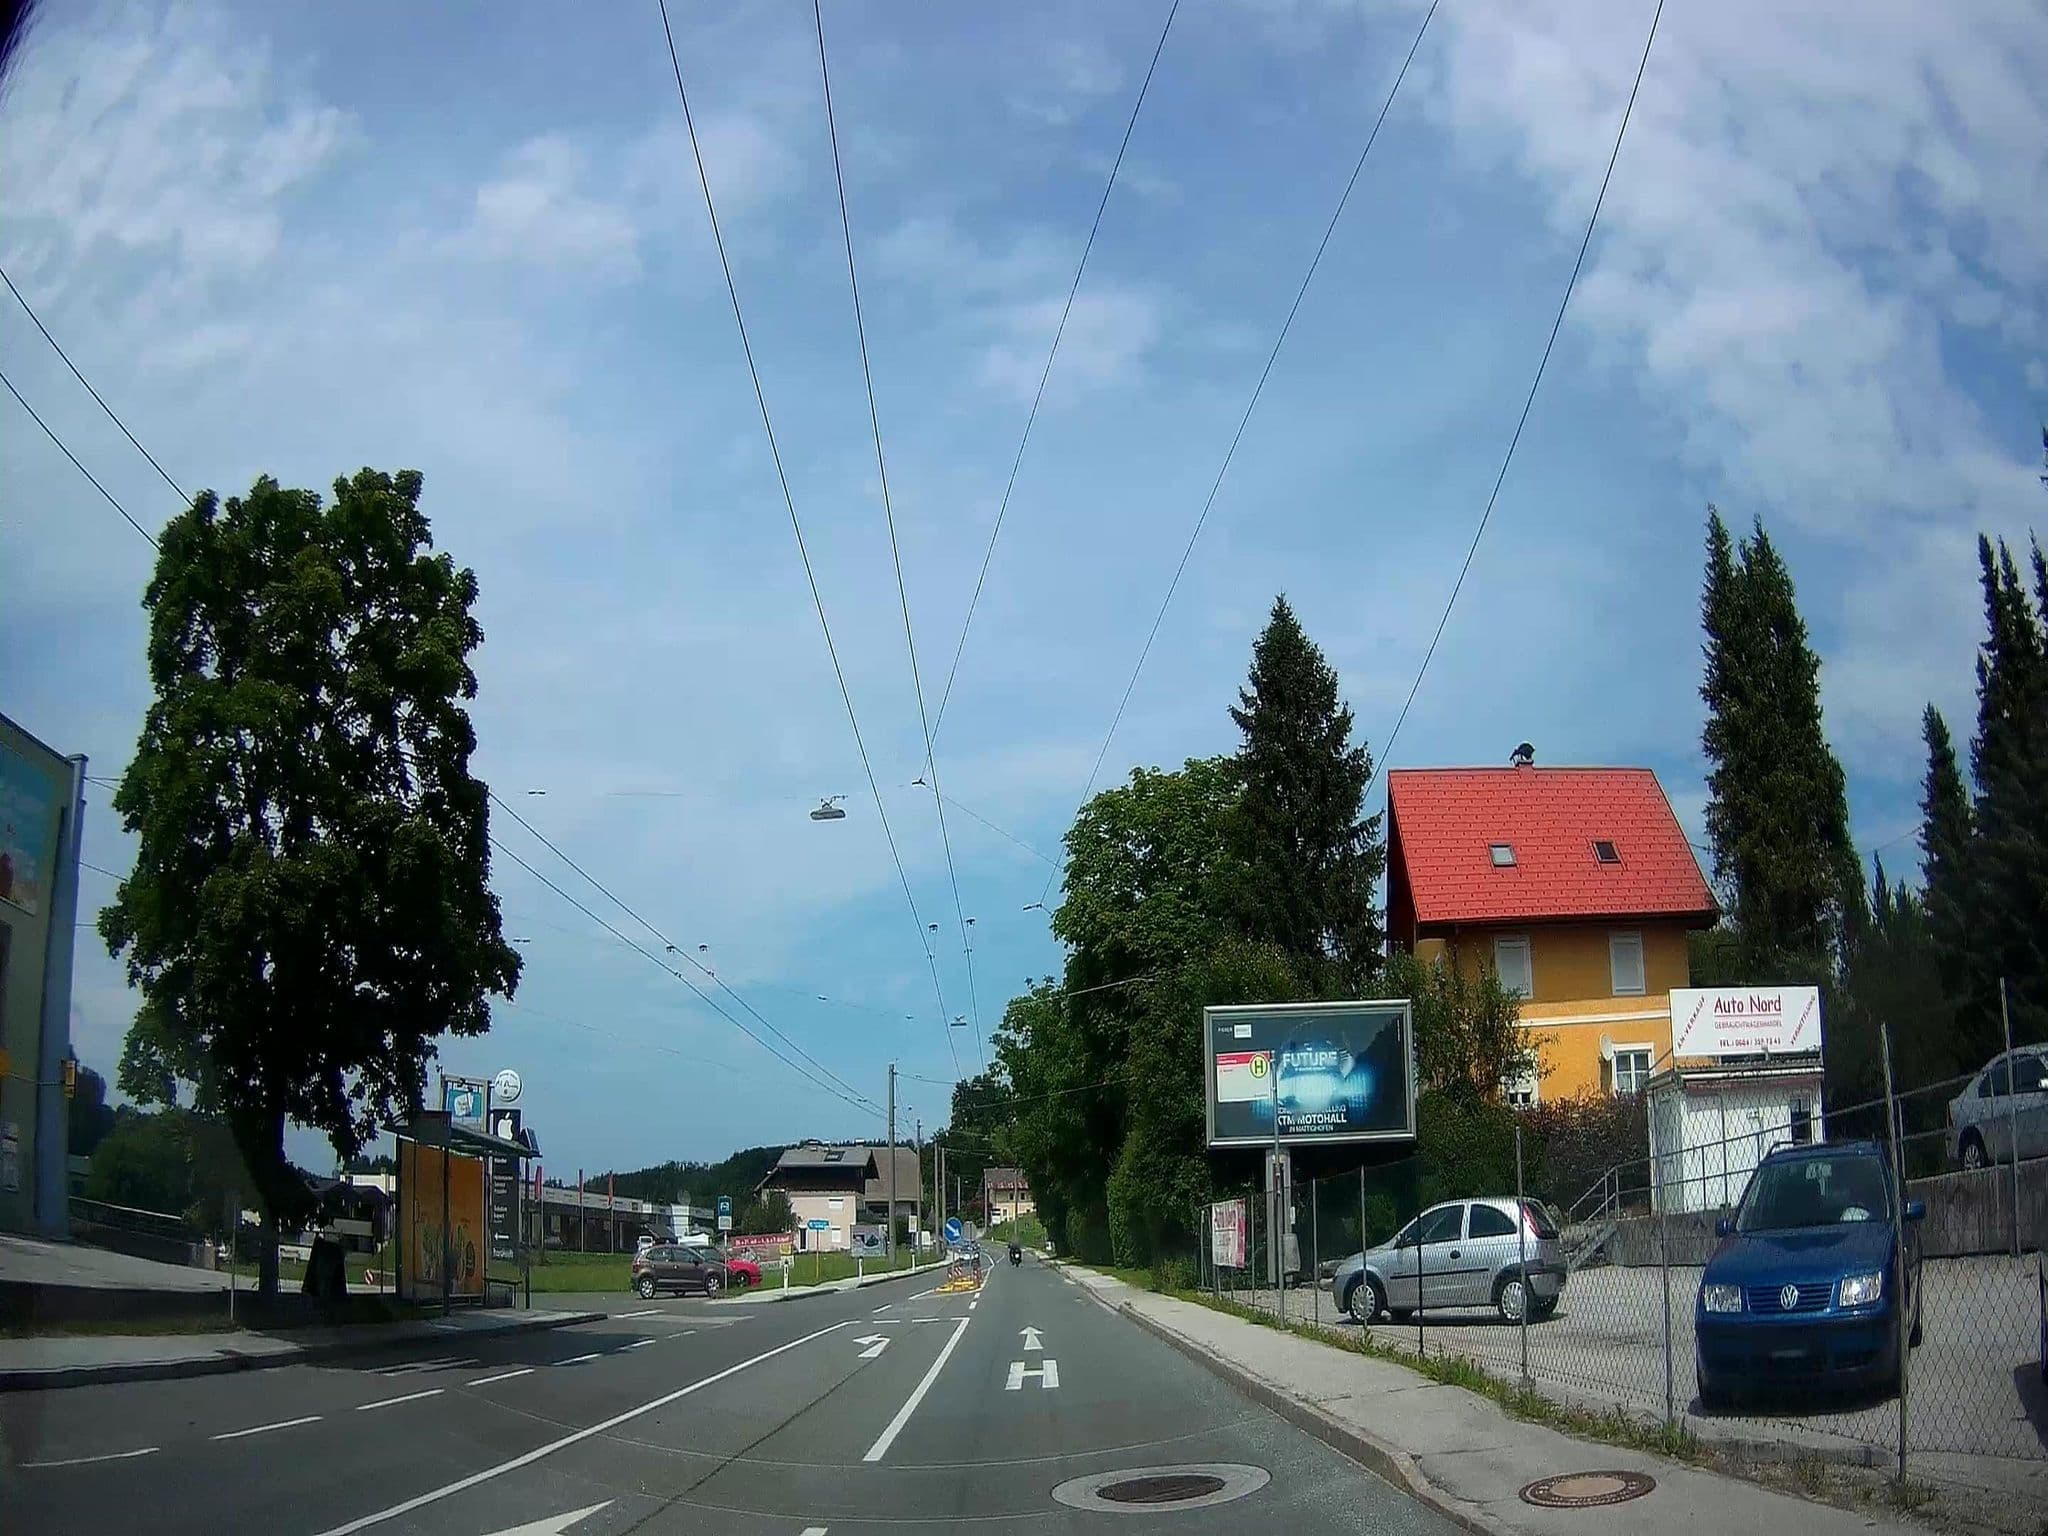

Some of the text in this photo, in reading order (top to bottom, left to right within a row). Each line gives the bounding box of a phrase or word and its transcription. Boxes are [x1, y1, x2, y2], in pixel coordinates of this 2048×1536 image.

[1714, 994, 1781, 1013] Auto Nord
[1254, 1059, 1264, 1074] H
[1282, 1051, 1338, 1067] FUTURE
[1297, 1113, 1347, 1125] MOTOHALL
[1004, 1358, 1060, 1391] H
